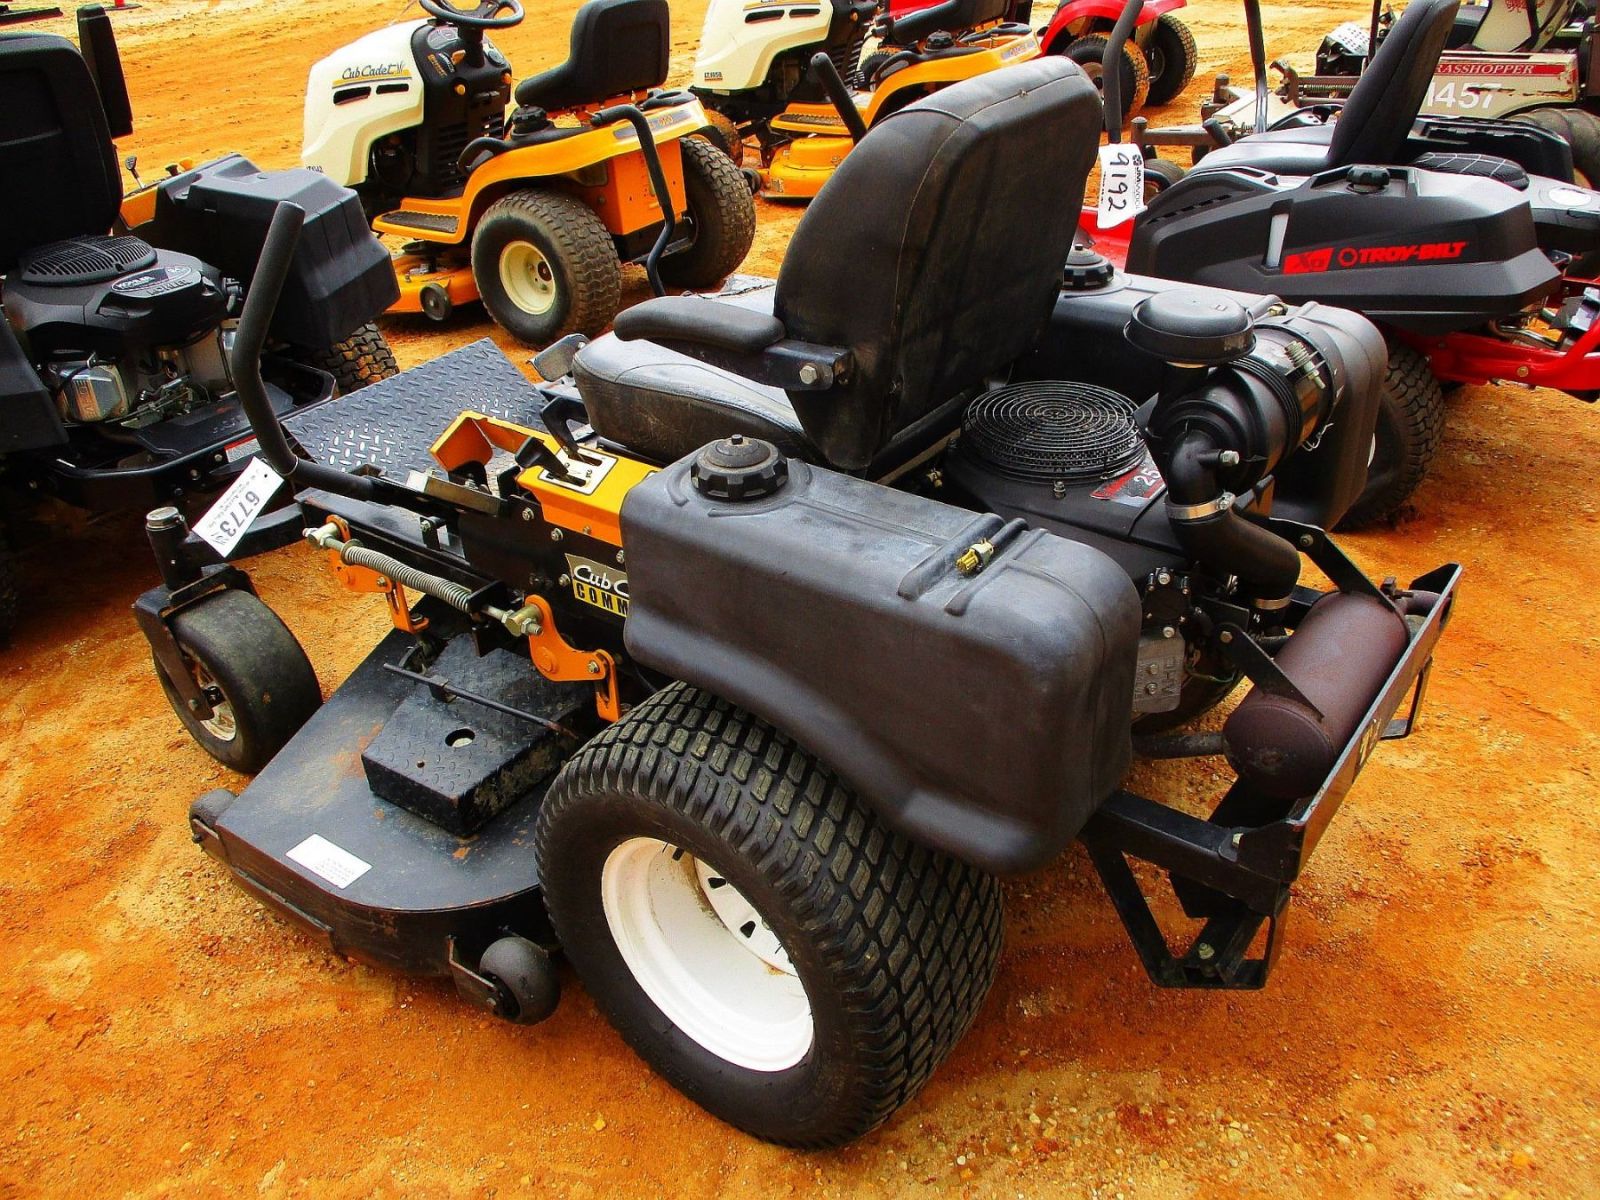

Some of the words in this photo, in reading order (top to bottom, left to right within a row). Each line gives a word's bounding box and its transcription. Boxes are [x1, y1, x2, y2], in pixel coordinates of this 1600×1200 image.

[342, 67, 361, 80] Cub
[361, 63, 397, 77] Cadet
[1107, 151, 1130, 212] 9192
[1359, 241, 1467, 264] TROY-BILT
[219, 490, 261, 538] 6773
[573, 564, 612, 590] Cub
